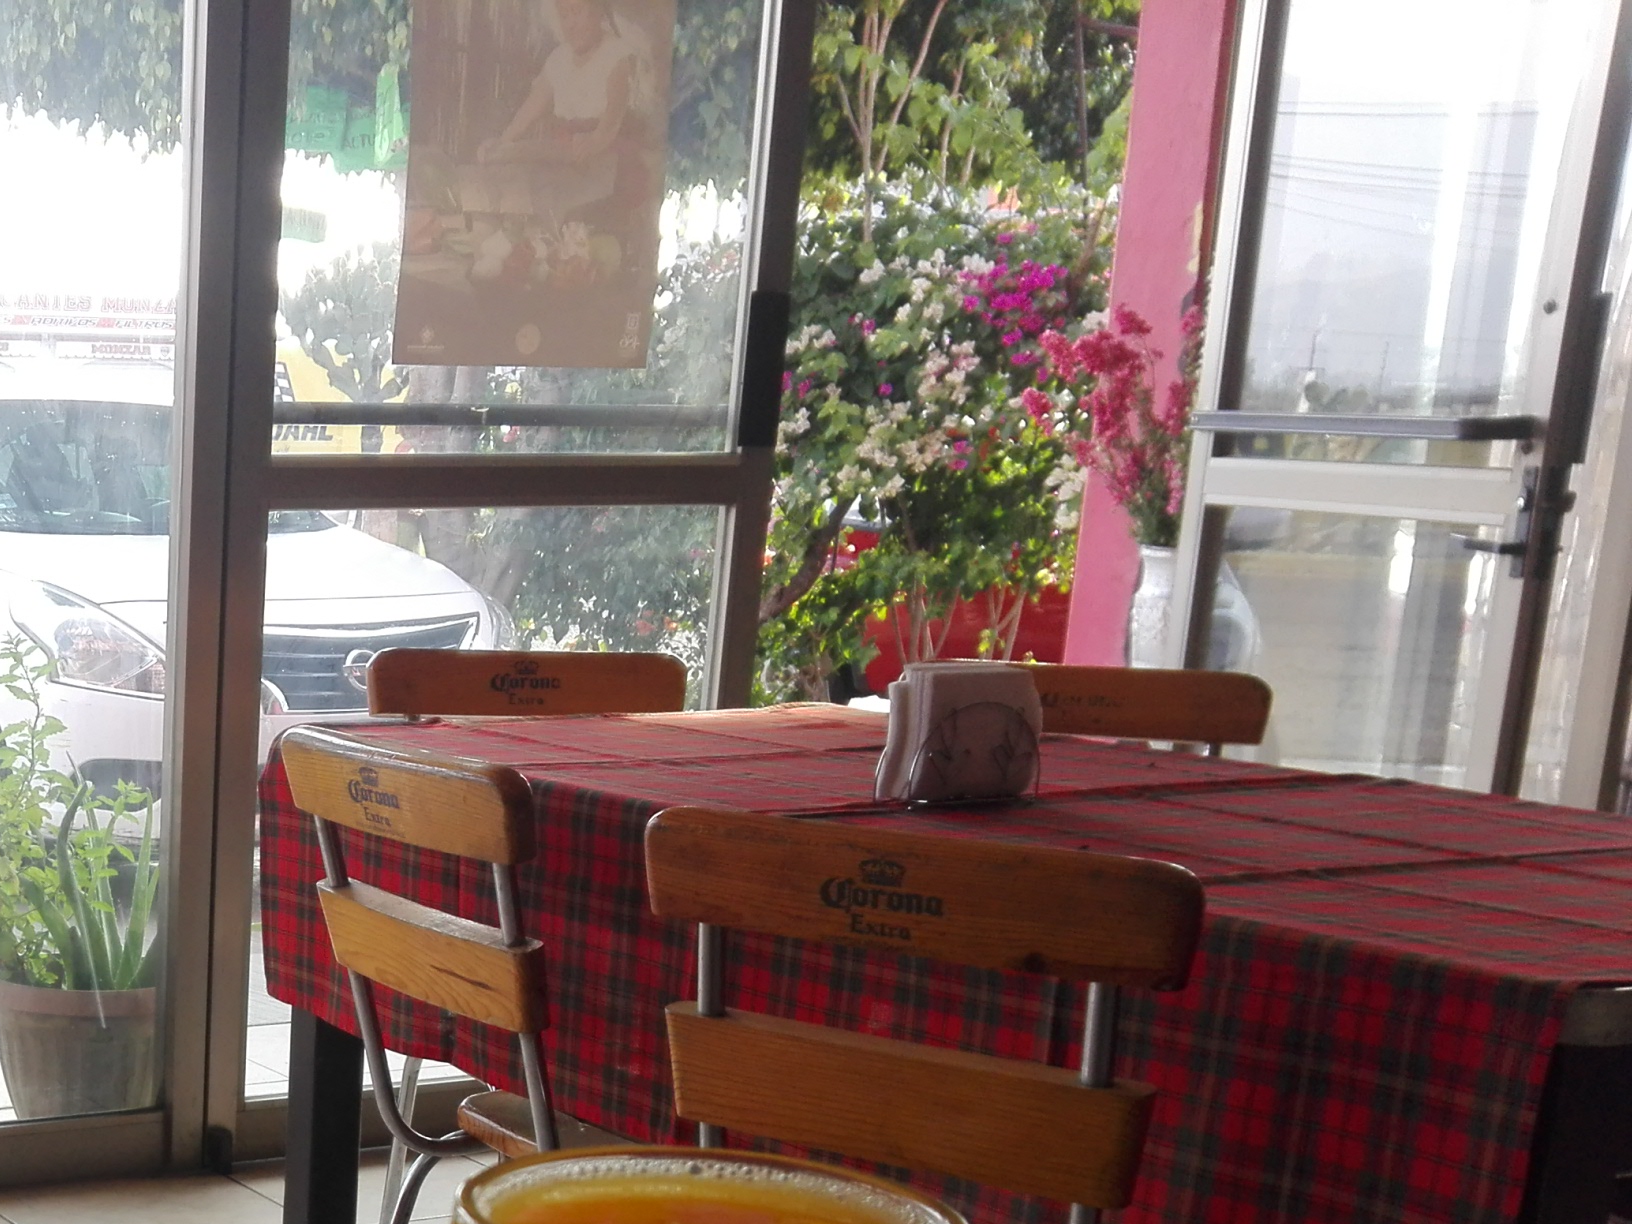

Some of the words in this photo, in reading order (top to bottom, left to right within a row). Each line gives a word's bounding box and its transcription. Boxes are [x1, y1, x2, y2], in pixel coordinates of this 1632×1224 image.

[490, 668, 561, 692] Corona
[347, 779, 401, 809] Corona
[363, 806, 392, 827] Extra
[819, 877, 944, 917] Corona
[850, 913, 912, 941] Extra
